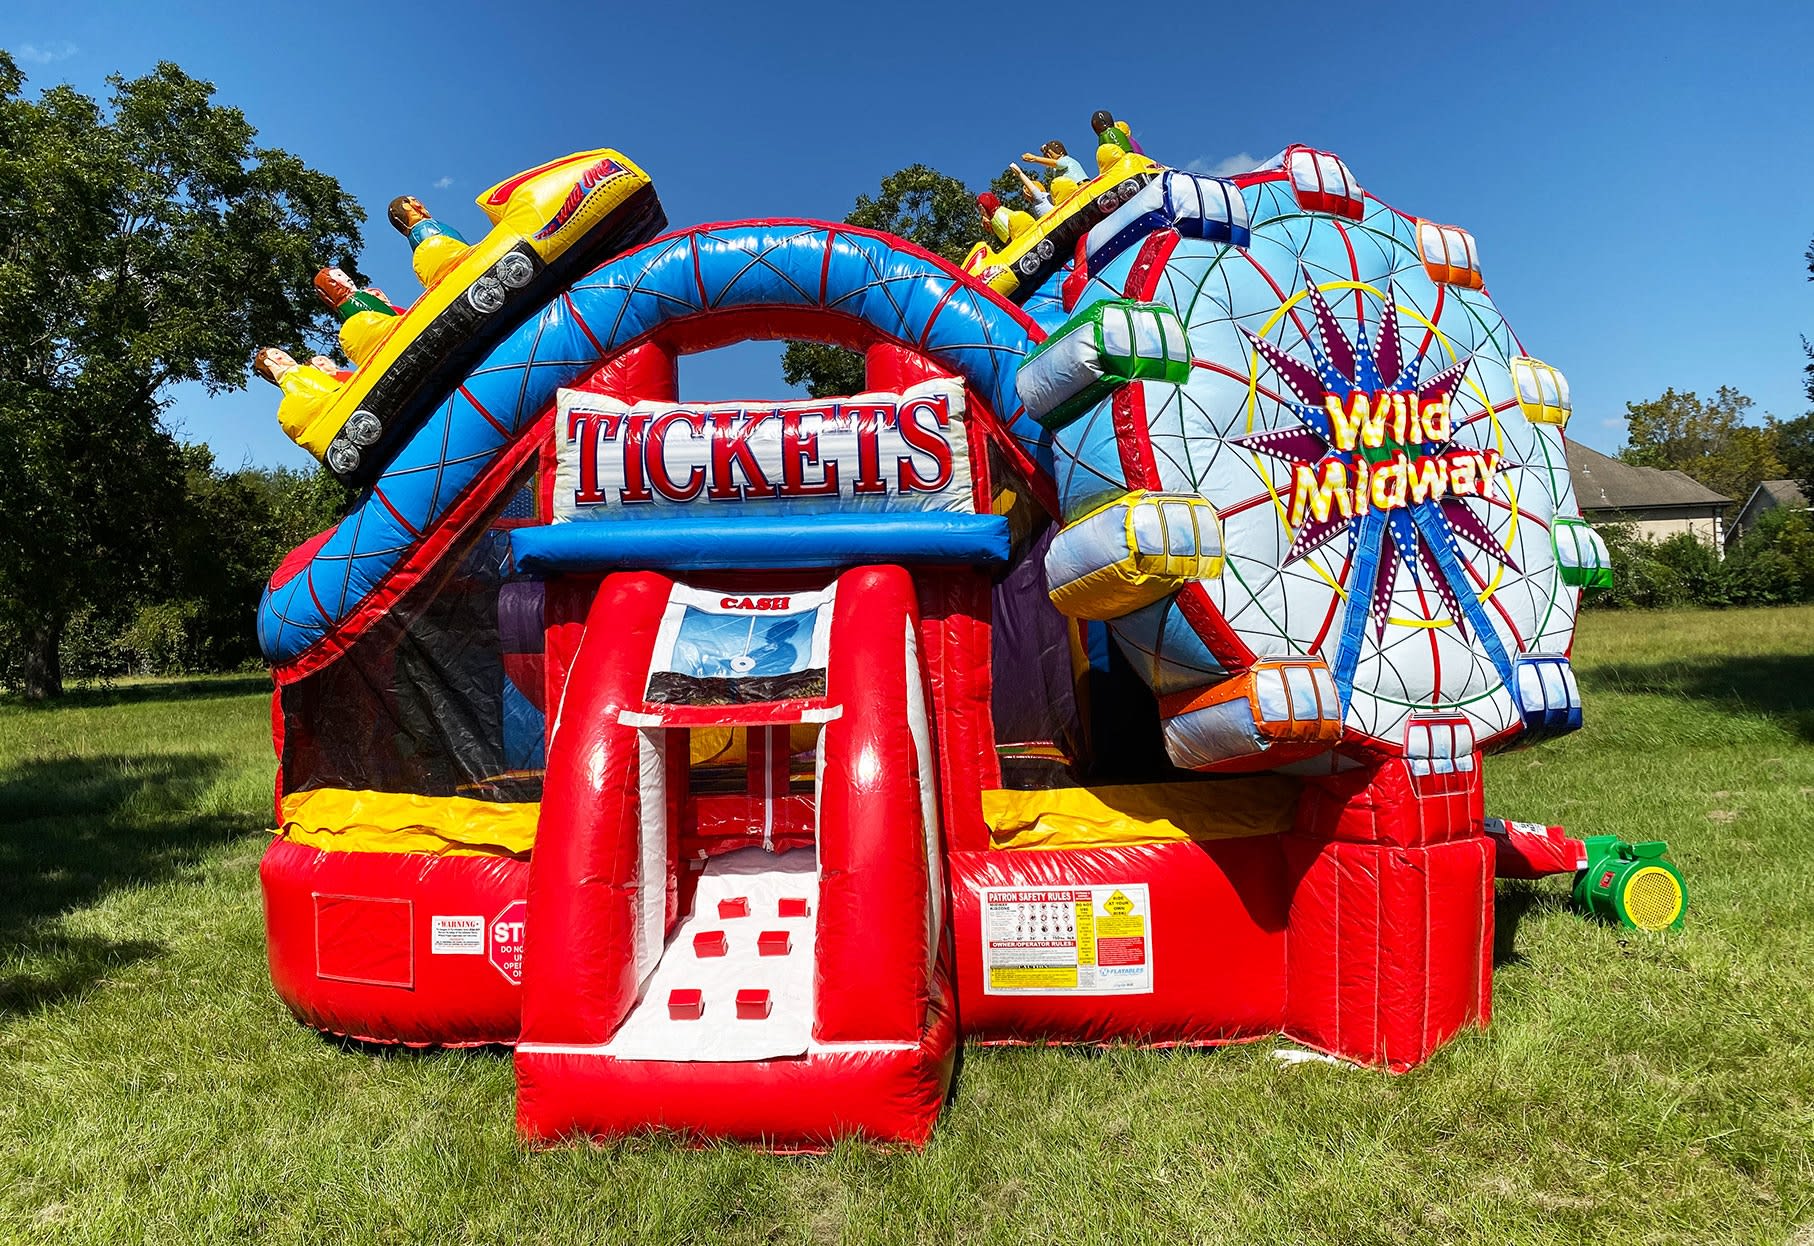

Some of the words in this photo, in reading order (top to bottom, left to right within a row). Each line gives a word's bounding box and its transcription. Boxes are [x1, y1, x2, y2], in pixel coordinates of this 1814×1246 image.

[567, 394, 953, 507] TICKETS
[720, 597, 791, 611] CASH
[989, 893, 1017, 901] PATRON
[1019, 892, 1046, 900] SAFETY
[1048, 891, 1071, 900] RULES
[494, 922, 525, 943] ST
